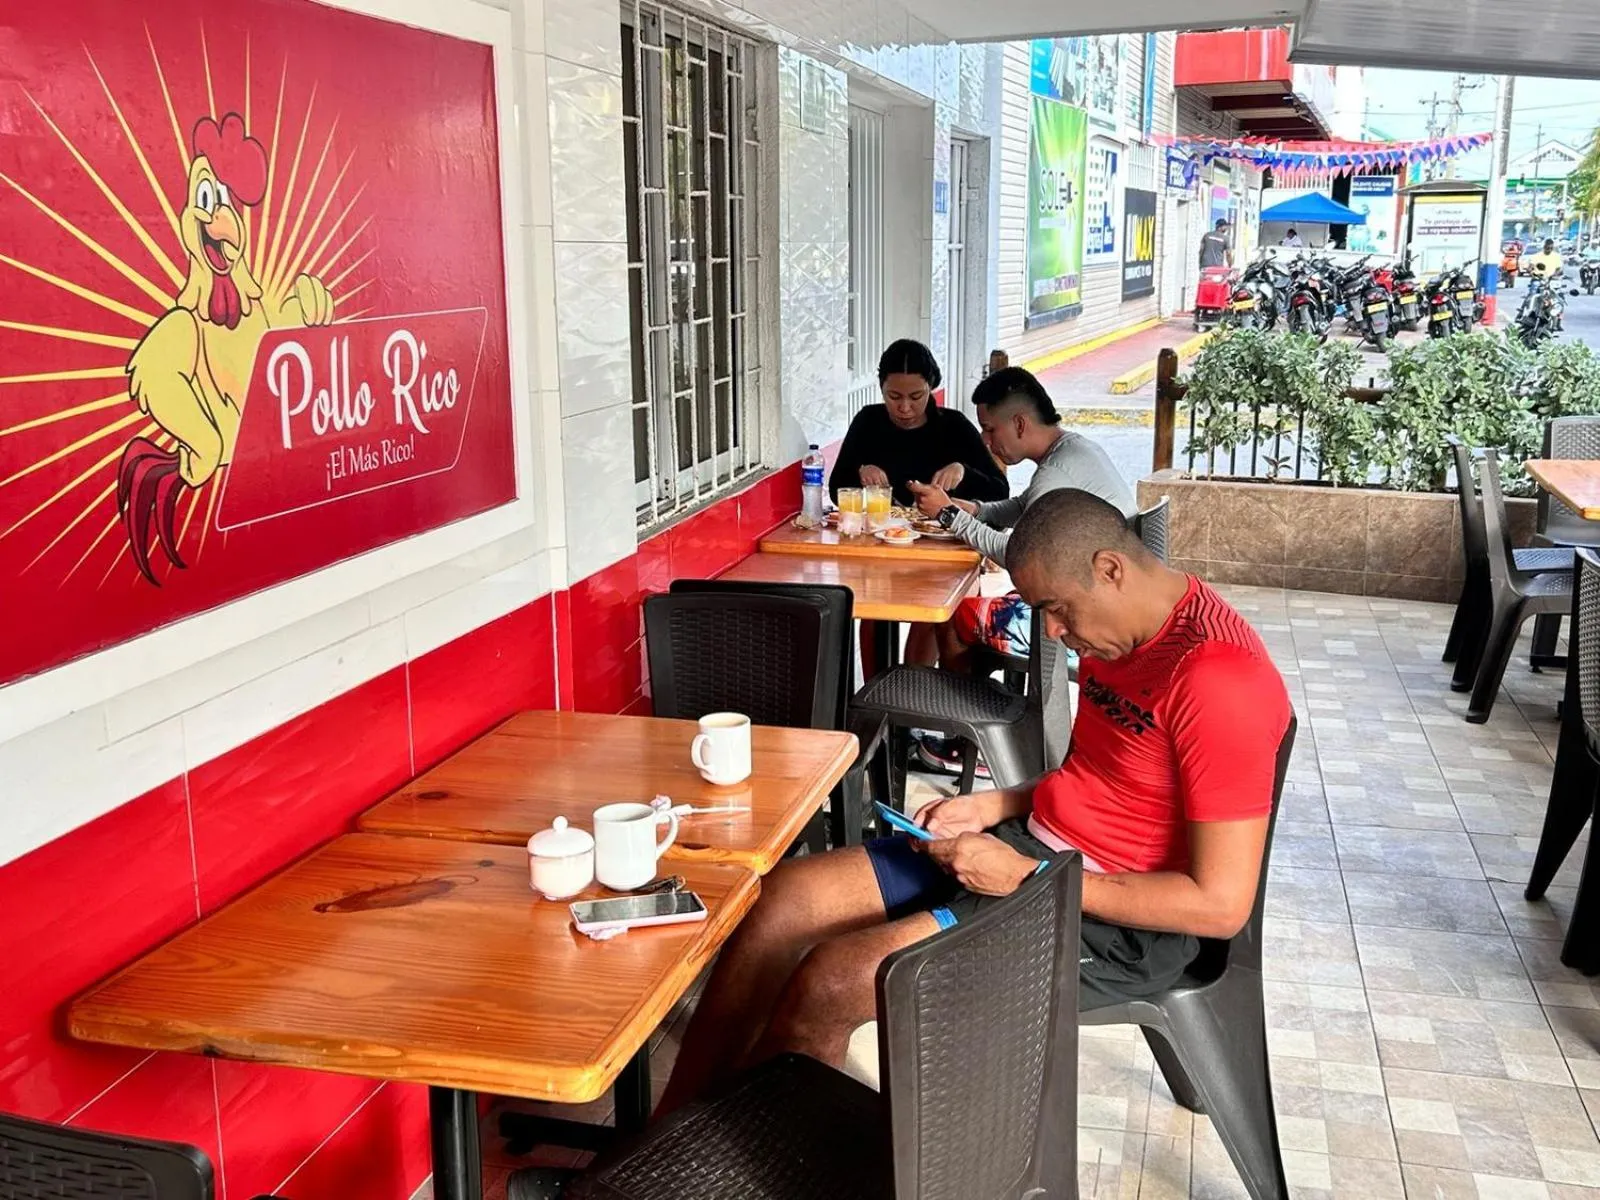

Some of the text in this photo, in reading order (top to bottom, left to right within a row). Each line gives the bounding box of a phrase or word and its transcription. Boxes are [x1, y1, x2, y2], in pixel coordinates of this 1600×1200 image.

[266, 329, 461, 449] Pollo Rico
[326, 433, 415, 491] ¡El Más Rico!
